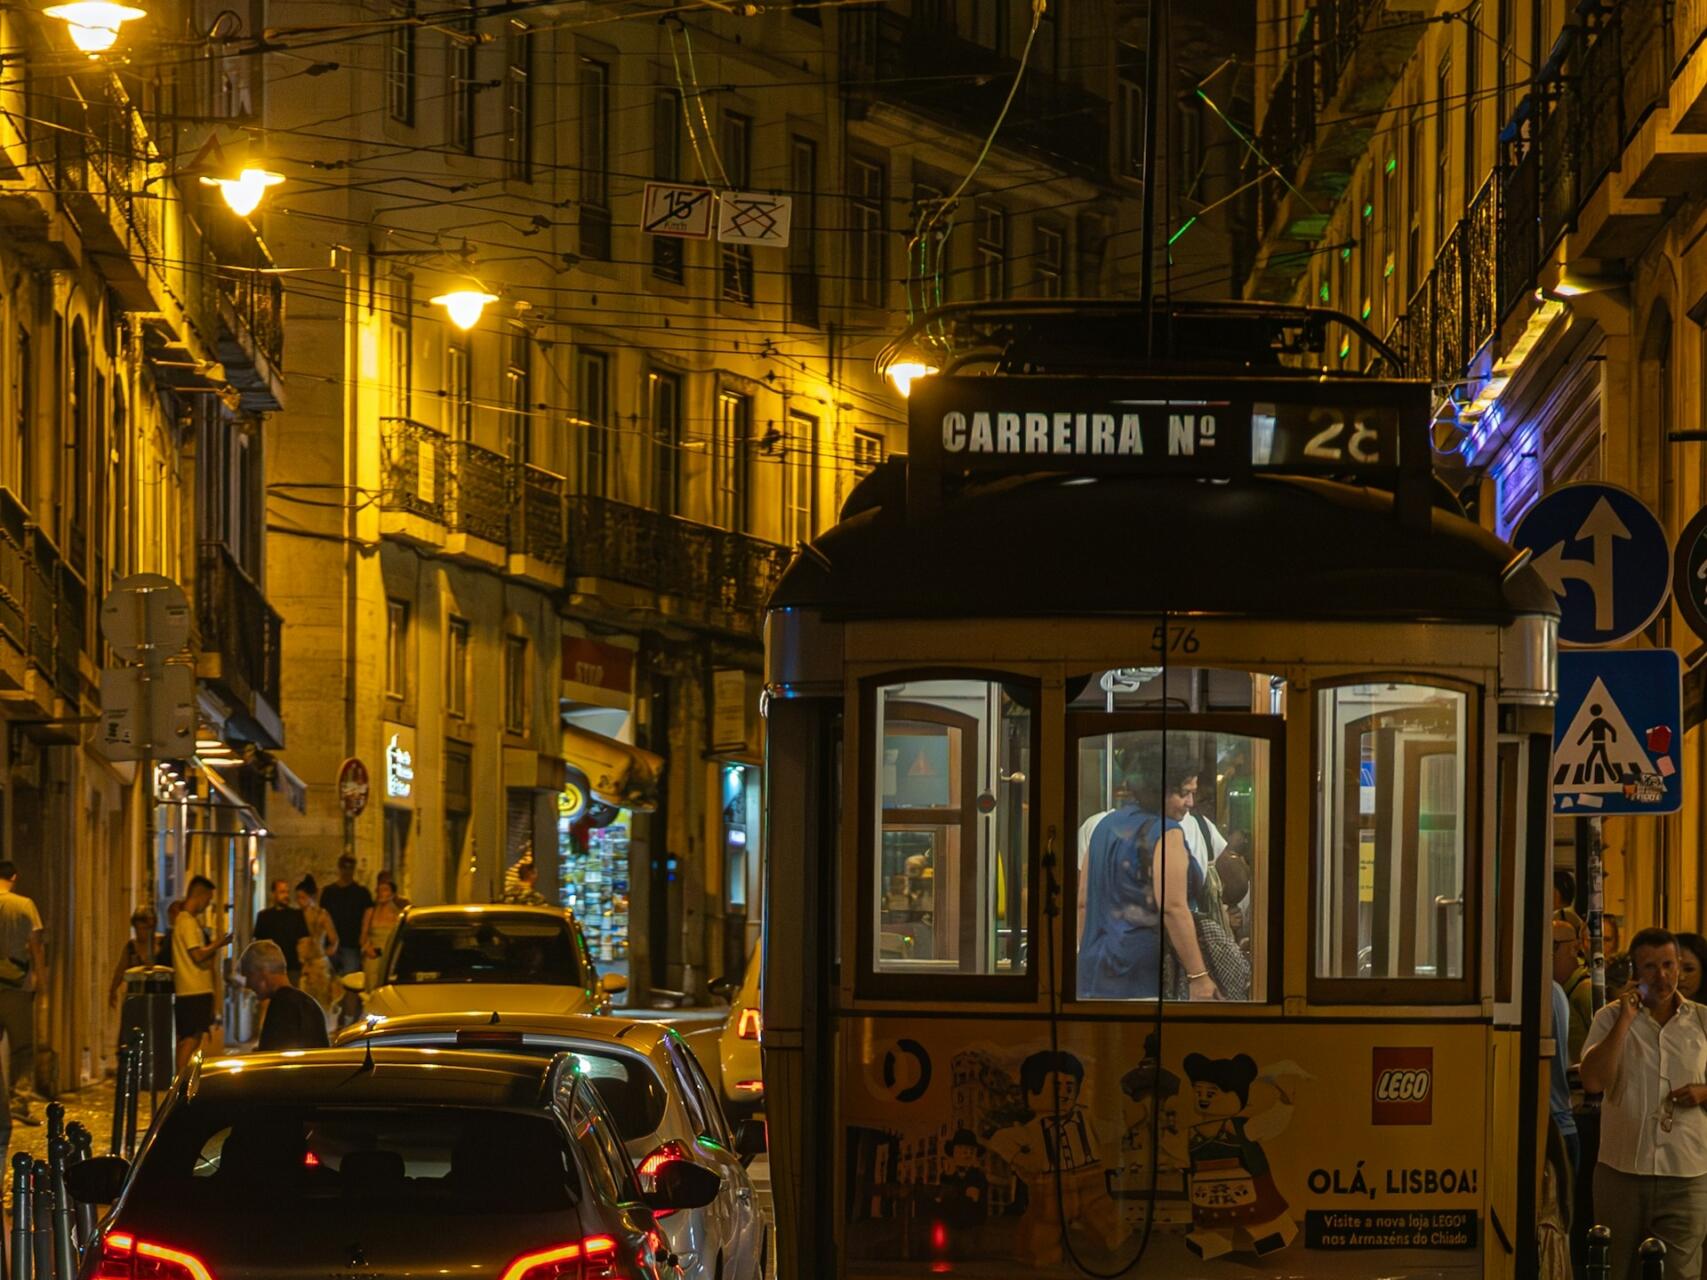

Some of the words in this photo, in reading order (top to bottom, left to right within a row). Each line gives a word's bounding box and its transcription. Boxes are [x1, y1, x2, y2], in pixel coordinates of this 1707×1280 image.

[663, 190, 693, 220] 15
[942, 411, 1144, 456] CARREIRA
[1167, 413, 1218, 457] Nº
[1151, 626, 1201, 654] 576
[1376, 1068, 1431, 1102] LEGO
[1307, 1160, 1377, 1200] OLÁ,
[1386, 1168, 1478, 1194] LISBOA!
[1323, 1214, 1362, 1228] Visite
[1364, 1218, 1372, 1228] a
[1376, 1217, 1405, 1228] nova
[1409, 1214, 1430, 1231] loja
[1322, 1234, 1346, 1246] nos
[1349, 1231, 1410, 1246] Armazéns
[1413, 1232, 1428, 1246] do
[1430, 1232, 1468, 1246] Chiado
